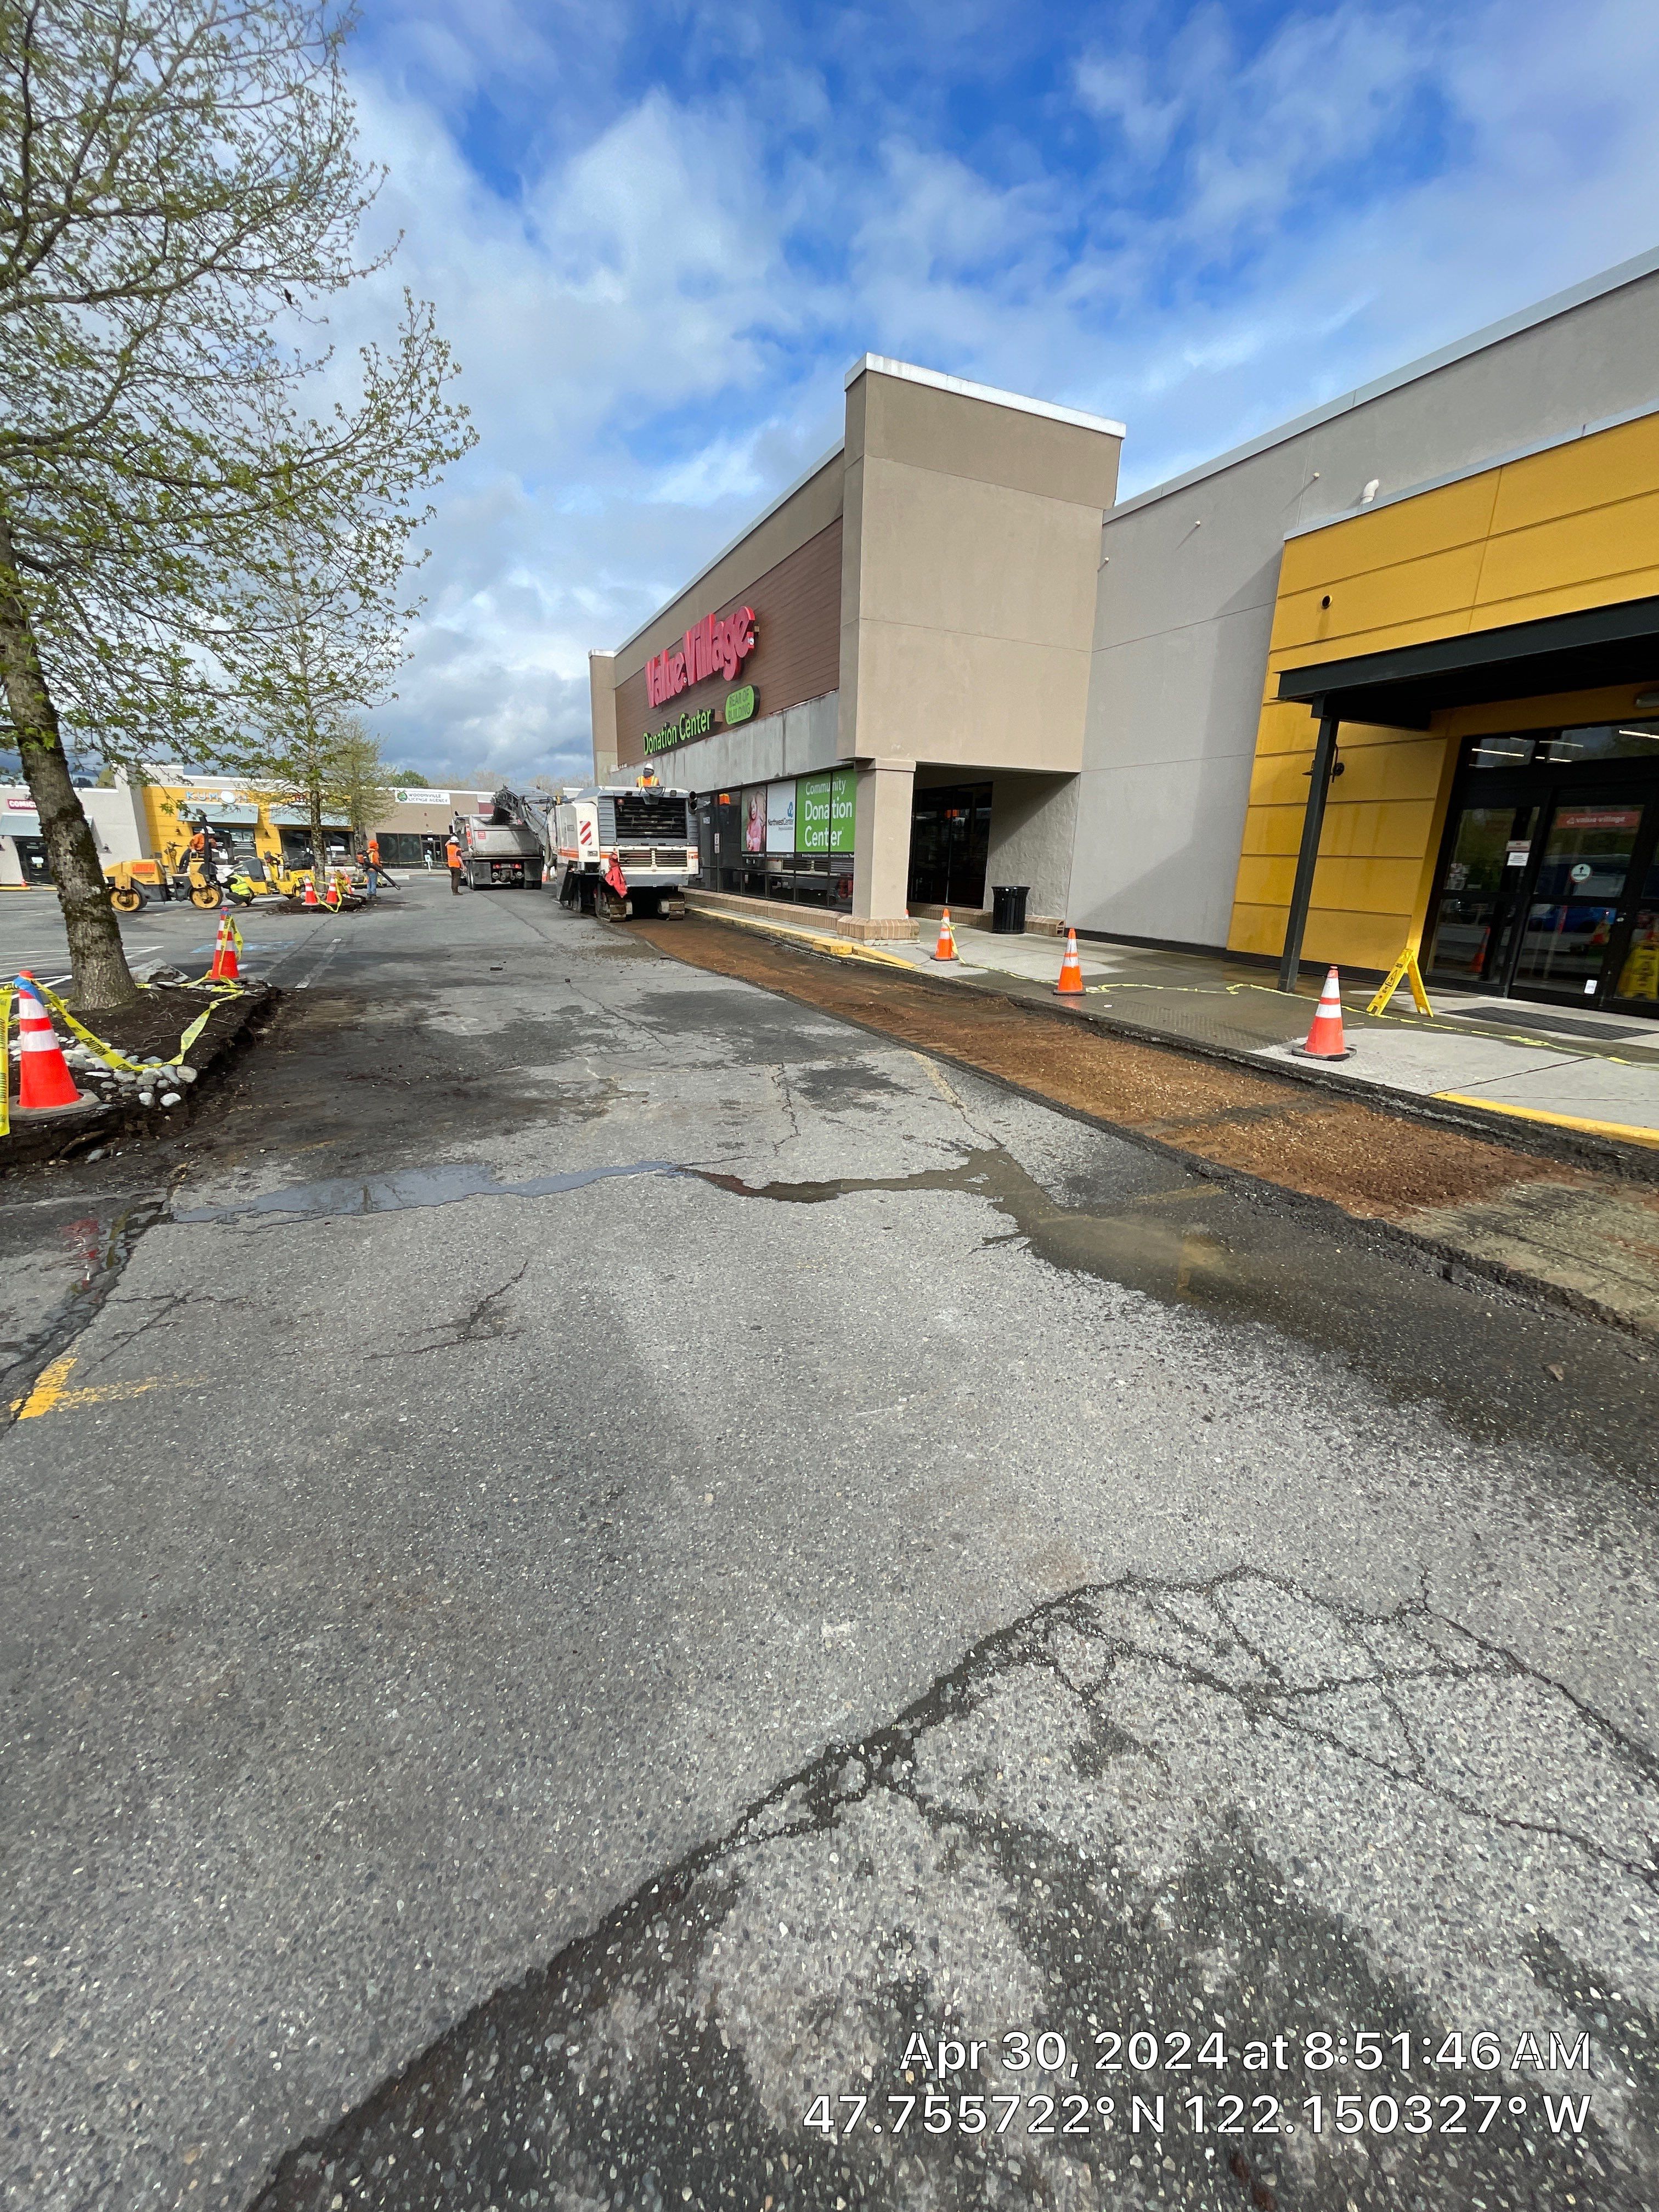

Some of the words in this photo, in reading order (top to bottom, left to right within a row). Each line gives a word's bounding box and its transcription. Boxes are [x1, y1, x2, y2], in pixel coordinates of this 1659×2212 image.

[645, 649, 686, 708] Value
[682, 606, 755, 686] Village
[644, 723, 678, 755] Donation
[679, 709, 712, 741] Center
[805, 777, 846, 795] Community
[805, 797, 853, 821] Donation
[805, 825, 843, 847] Center
[81, 1037, 110, 1057] CAUTION
